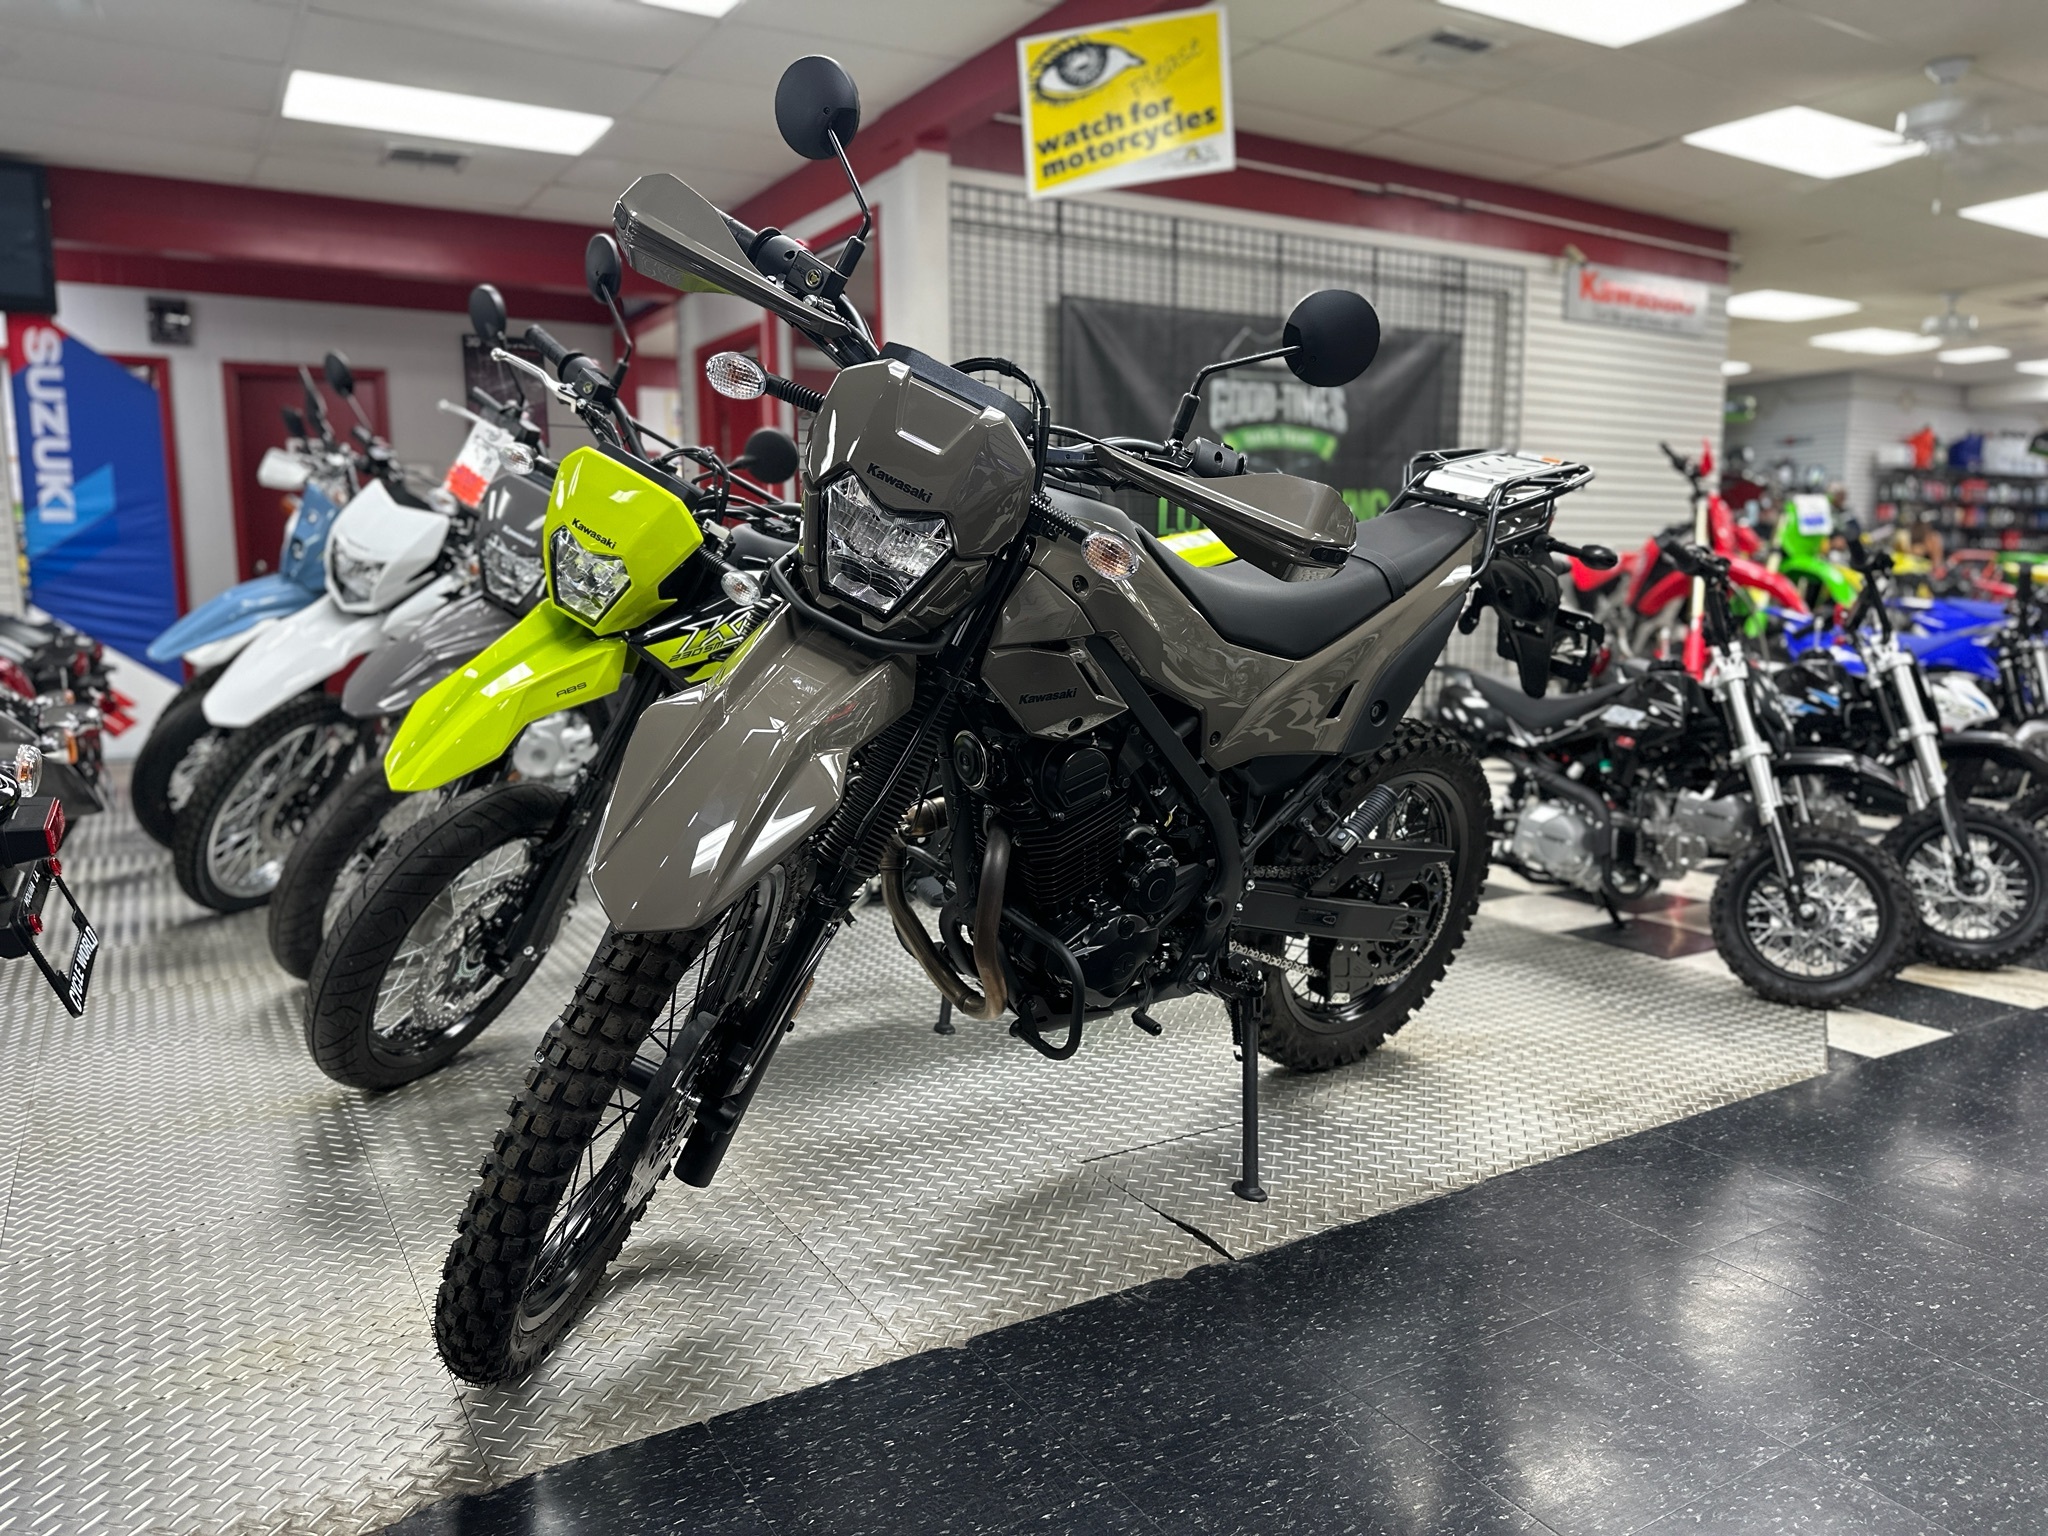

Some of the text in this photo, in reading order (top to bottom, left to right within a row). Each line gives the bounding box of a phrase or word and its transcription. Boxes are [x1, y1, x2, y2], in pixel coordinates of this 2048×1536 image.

[1036, 112, 1124, 156] watch
[1129, 97, 1174, 125] for
[1041, 106, 1217, 179] motorcycles
[22, 325, 77, 525] SUZUKI
[866, 462, 934, 504] Kawasaki
[571, 517, 617, 550] Kawasaki
[556, 681, 587, 698] ABS
[1018, 687, 1078, 705] Kawasaki
[68, 925, 99, 1013] CYCLE WORLD
